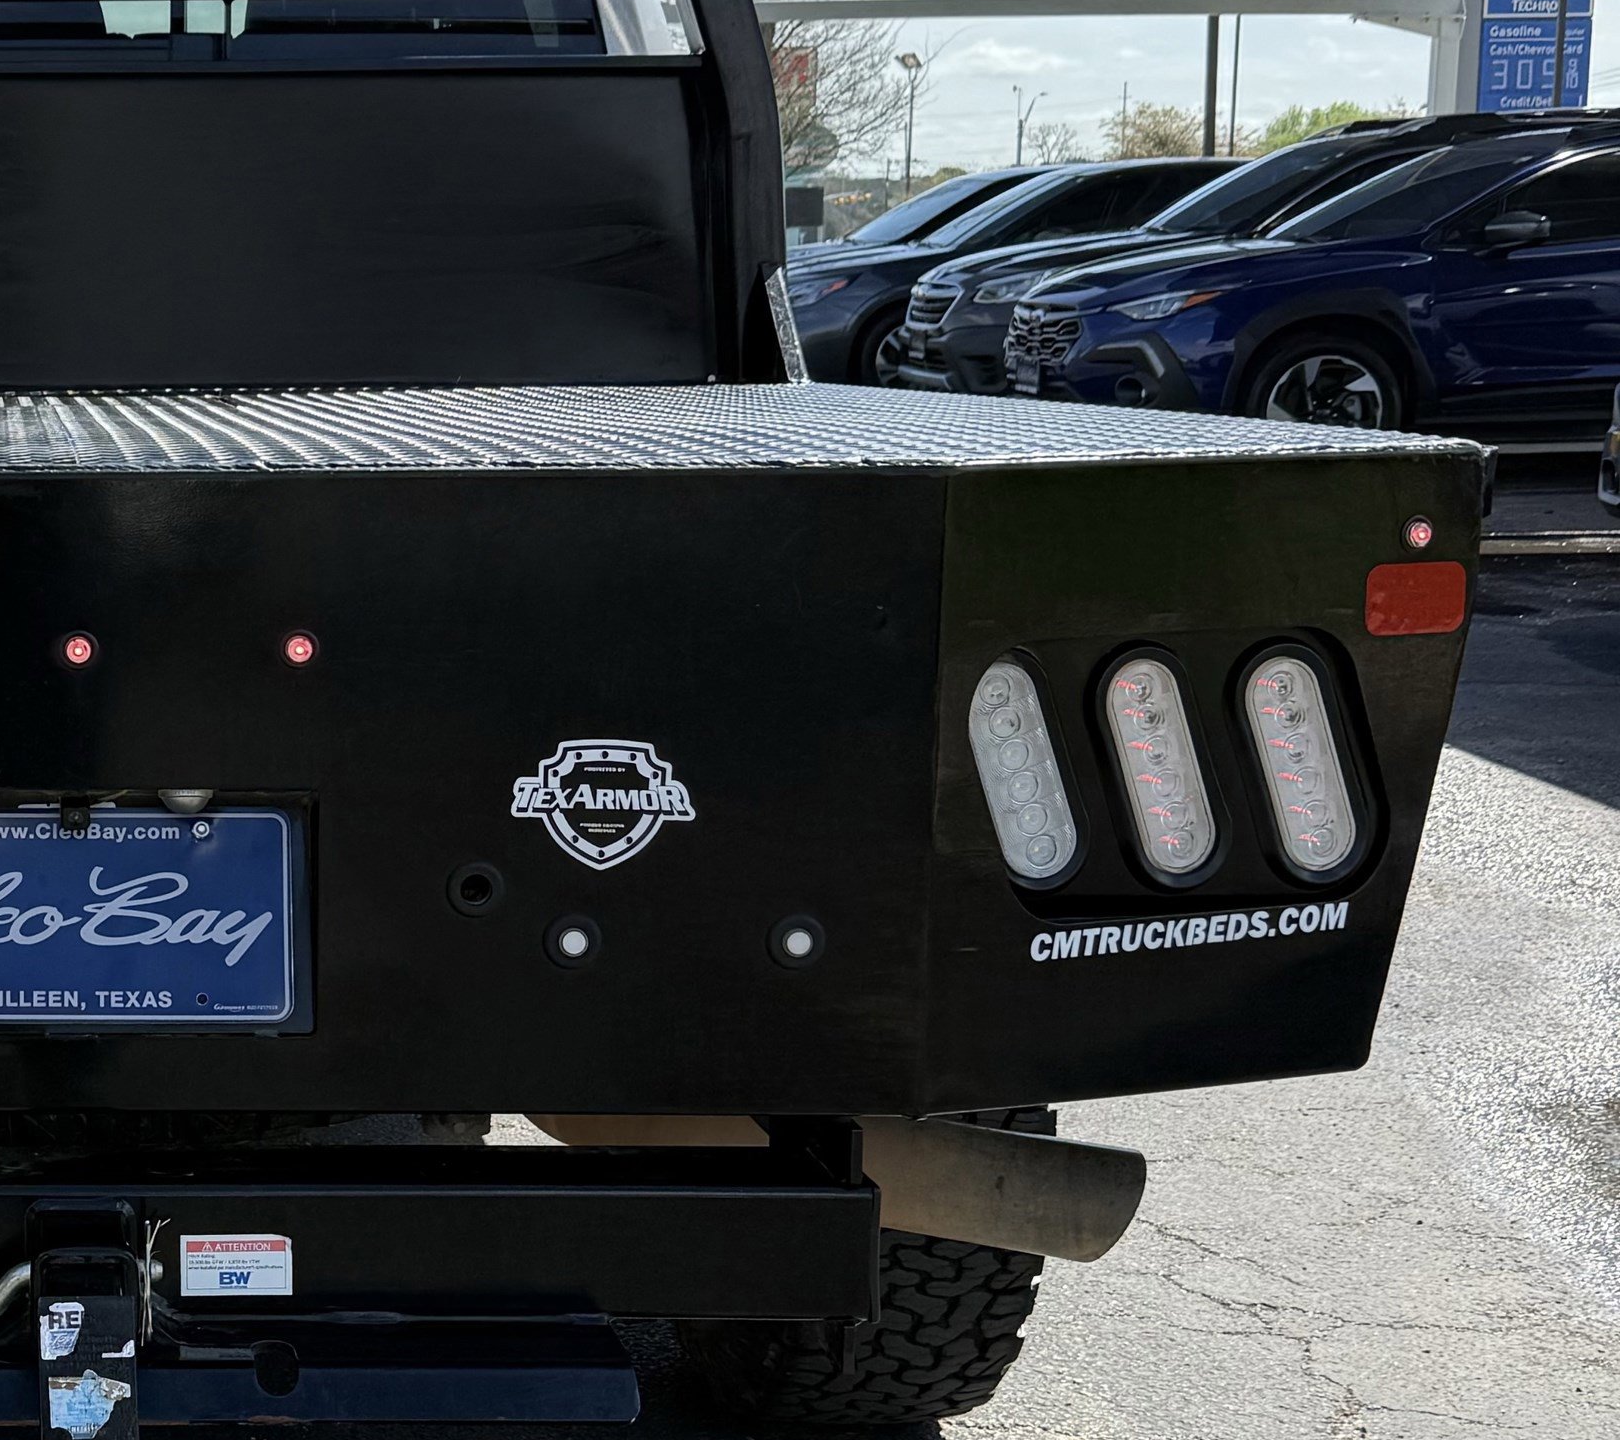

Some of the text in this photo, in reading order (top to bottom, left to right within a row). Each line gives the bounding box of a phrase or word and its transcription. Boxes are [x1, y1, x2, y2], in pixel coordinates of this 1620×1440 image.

[1511, 0, 1558, 13] TECHRO
[1489, 24, 1541, 37] Gasoline
[1500, 95, 1554, 108] Credit/Deb
[80, 866, 273, 966] Bay
[1030, 901, 1350, 962] CMTRUCKBEDS.COM
[95, 990, 173, 1009] TEXAS
[214, 1242, 271, 1252] ATTENTION
